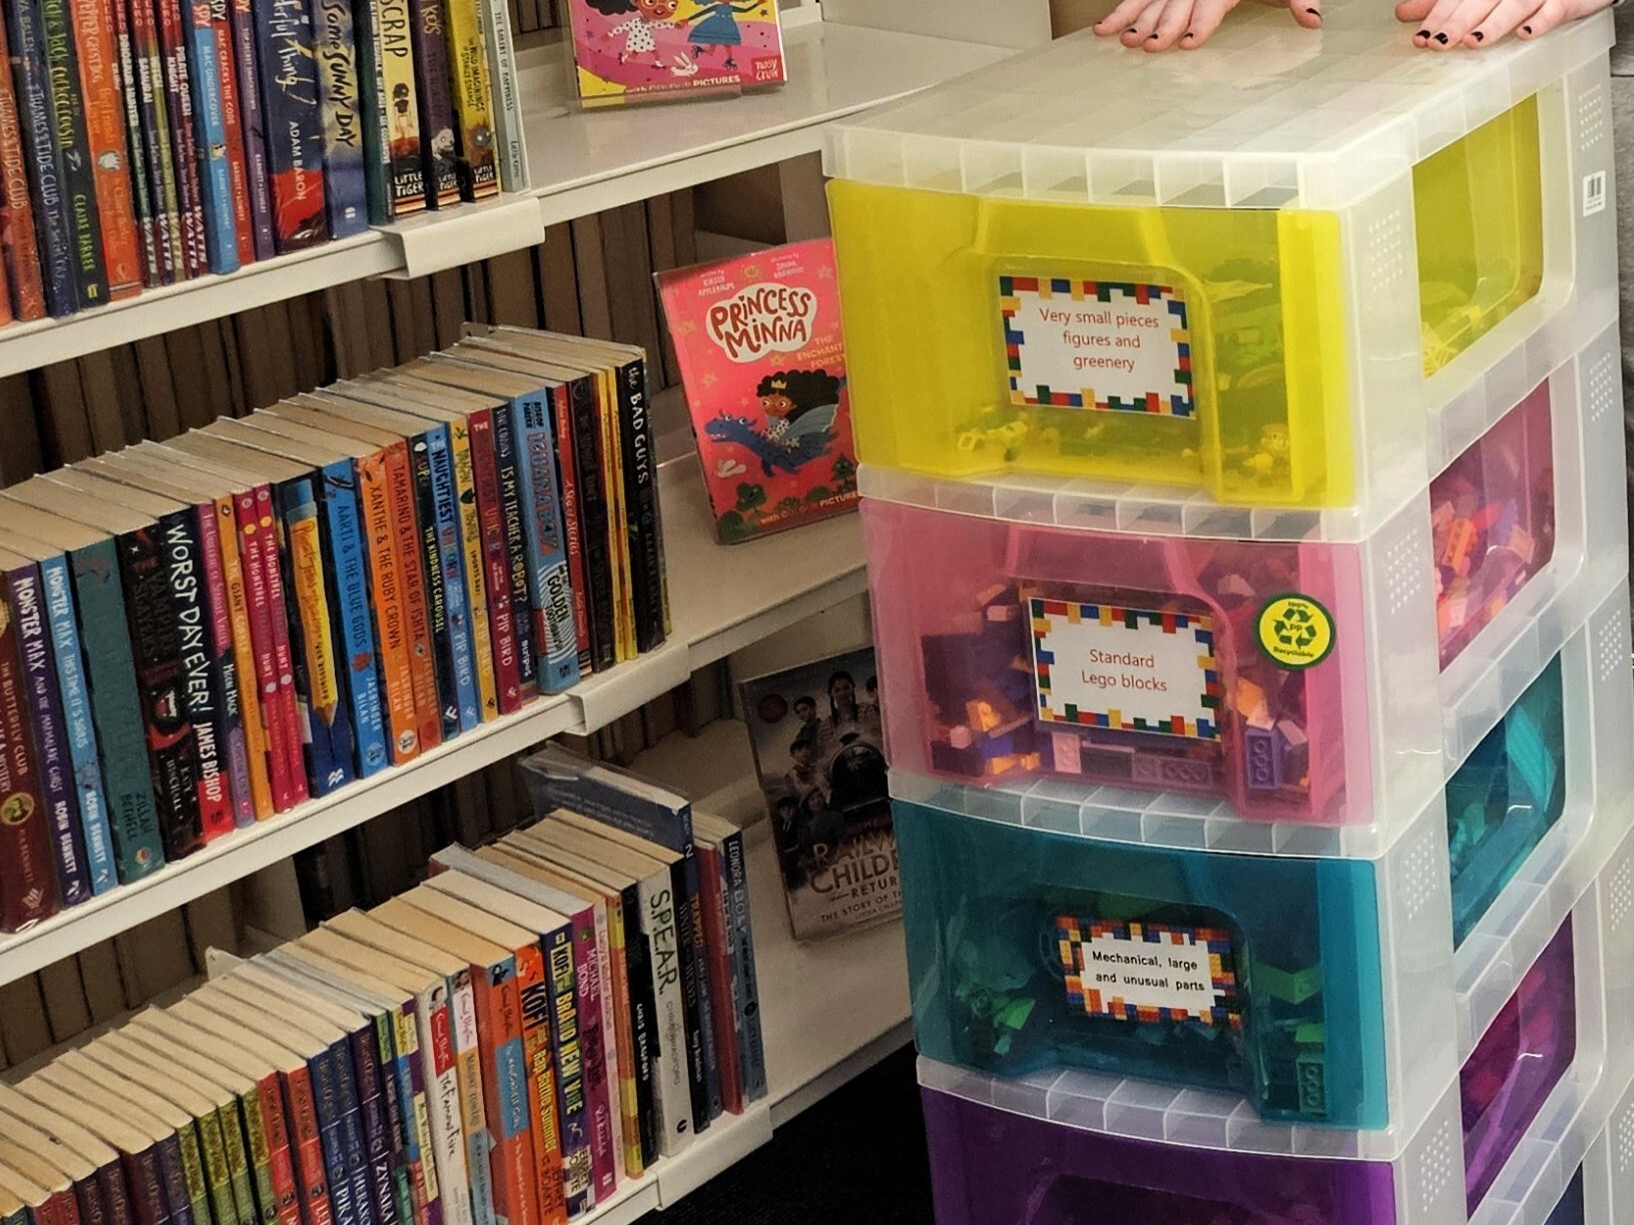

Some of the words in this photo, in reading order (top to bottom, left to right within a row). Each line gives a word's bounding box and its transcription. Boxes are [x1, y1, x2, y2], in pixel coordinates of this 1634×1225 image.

[693, 75, 740, 88] PICTURES
[287, 120, 303, 156] ADAM
[333, 110, 358, 149] DAY
[291, 157, 308, 200] BARON
[395, 171, 423, 184] LITTLE
[396, 182, 424, 197] TIGER
[710, 287, 812, 340] PRINCESS
[1040, 308, 1071, 326] Very
[1076, 312, 1111, 323] small
[1116, 314, 1159, 328] pieces
[724, 316, 807, 359] MINNA
[1063, 331, 1110, 348] figures
[1115, 336, 1140, 348] and
[626, 366, 642, 391] the
[1074, 355, 1135, 373] greenery
[629, 392, 645, 431] BAD
[632, 435, 651, 484] GUYS
[430, 449, 454, 524] NAUGHTIEST
[368, 484, 388, 532] XANTHE
[375, 534, 389, 544] &
[165, 524, 199, 604] WORST
[377, 545, 393, 569] THE
[381, 572, 397, 602] RUBY
[175, 607, 204, 651] DAY
[385, 604, 403, 650] CROWN
[496, 614, 509, 633] PIP
[498, 636, 513, 666] BIRD
[1090, 649, 1154, 668] Standard
[182, 653, 214, 714] EVER!
[1082, 671, 1117, 689] Lego
[1122, 674, 1167, 692] blocks
[193, 721, 216, 761] JAMES
[201, 760, 222, 803] BISHOP
[851, 876, 897, 899] RETUR
[647, 889, 681, 996] S.P.E.A.R.
[551, 946, 572, 977] KOFI
[1092, 951, 1162, 968] Mechanical,
[1169, 958, 1197, 972] large
[1096, 973, 1116, 983] and
[1124, 976, 1168, 988] unusual
[1176, 980, 1205, 992] parts
[518, 982, 550, 1030] KOFI
[553, 992, 576, 1042] BRAND
[531, 1050, 549, 1073] Rap
[558, 1043, 582, 1078] NEW
[535, 1071, 554, 1107] Battle
[538, 1106, 559, 1154] Summer
